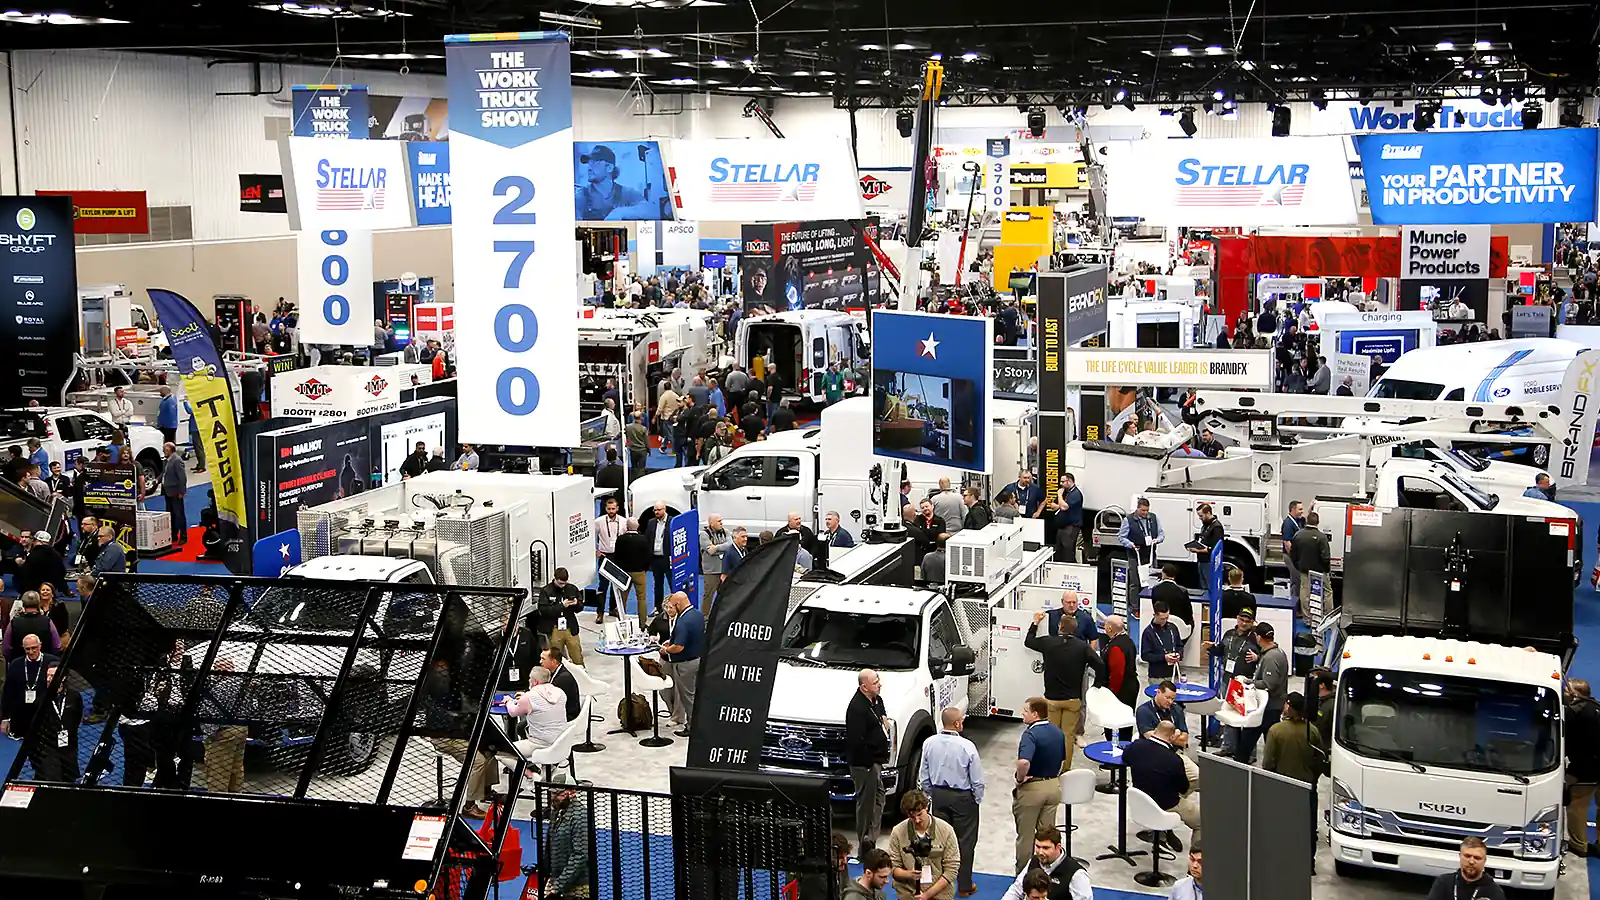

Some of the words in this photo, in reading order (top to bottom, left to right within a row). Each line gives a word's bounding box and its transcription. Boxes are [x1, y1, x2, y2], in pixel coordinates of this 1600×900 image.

[490, 51, 525, 68] THE
[478, 70, 539, 88] WORK
[319, 96, 341, 107] THE
[479, 91, 540, 108] TRUCK
[310, 108, 350, 120] WORK
[311, 121, 350, 132] TRUCK
[418, 172, 443, 187] MADE
[1380, 174, 1426, 188] YOUR
[1429, 162, 1565, 188] PARTNER
[993, 162, 1003, 207] 3700
[1382, 188, 1406, 206] IN
[1407, 184, 1576, 206] PRODUCTIVITY
[81, 208, 101, 216] TAYLOR
[123, 208, 135, 216] LIFT
[667, 225, 694, 234] APSCO
[781, 232, 791, 242] THE
[791, 230, 810, 241] FUTURE
[811, 229, 818, 238] OF
[818, 227, 835, 238] LIFTING
[1409, 230, 1468, 244] Muncie
[0, 234, 56, 246] SHYFT
[781, 240, 814, 255] STRONG,
[816, 237, 836, 252] LONG,
[837, 235, 855, 248] LIGHT
[1409, 245, 1460, 260] Power
[1409, 260, 1481, 275] Products
[492, 175, 541, 417] 2700
[1361, 312, 1402, 323] Charging
[1045, 318, 1059, 338] LAST
[1045, 339, 1059, 350] TO
[273, 359, 293, 373] WIN!
[1045, 350, 1059, 372] BUILT
[1085, 360, 1099, 373] THE
[1101, 360, 1117, 373] LIFE
[1118, 361, 1143, 374] CYCLE
[1144, 361, 1168, 374] VALUE
[1169, 362, 1198, 375] LEADER
[1199, 362, 1208, 375] IS
[1209, 362, 1247, 375] BRANDFX
[1004, 366, 1034, 380] Story
[299, 383, 328, 396] IMT
[367, 379, 386, 393] IMT
[1524, 385, 1545, 395] MOBILE
[282, 408, 316, 417] BOOTH
[318, 410, 347, 418] #2801
[356, 406, 380, 417] BOOTH
[196, 395, 235, 498] TAFCO
[292, 439, 323, 456] MAILHOT
[673, 530, 687, 546] FREE
[673, 542, 687, 557] GIFT
[727, 621, 773, 641] FORGED
[723, 663, 738, 680] IN
[741, 665, 763, 683] THE
[718, 705, 753, 724] FIRES
[709, 747, 724, 763] OF
[727, 747, 749, 764] THE
[1418, 802, 1466, 815] ISUZU
